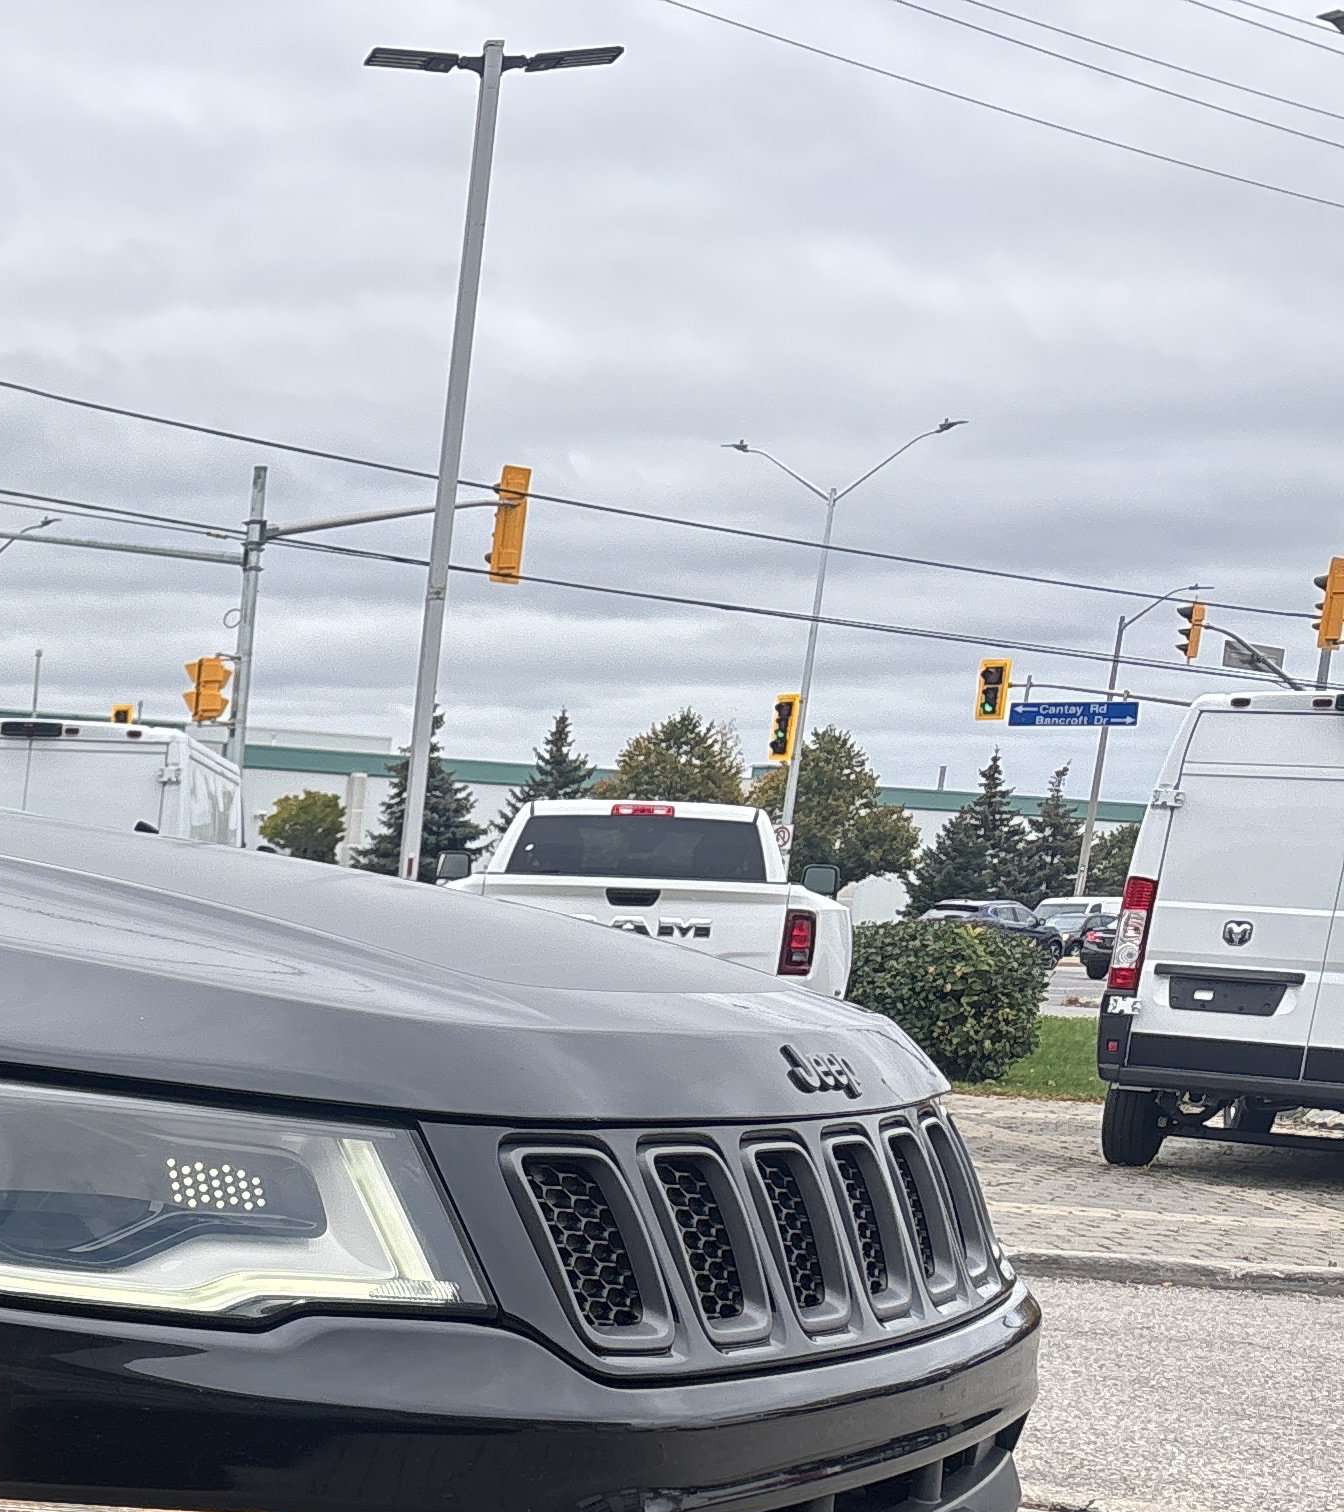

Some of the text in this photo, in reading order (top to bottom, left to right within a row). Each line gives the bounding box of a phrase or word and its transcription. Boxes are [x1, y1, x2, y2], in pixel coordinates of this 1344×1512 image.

[1039, 704, 1107, 714] Cantay Rd
[1035, 716, 1108, 725] Bancroft Dr
[574, 914, 712, 938] AM
[779, 1044, 863, 1100] Jeep
